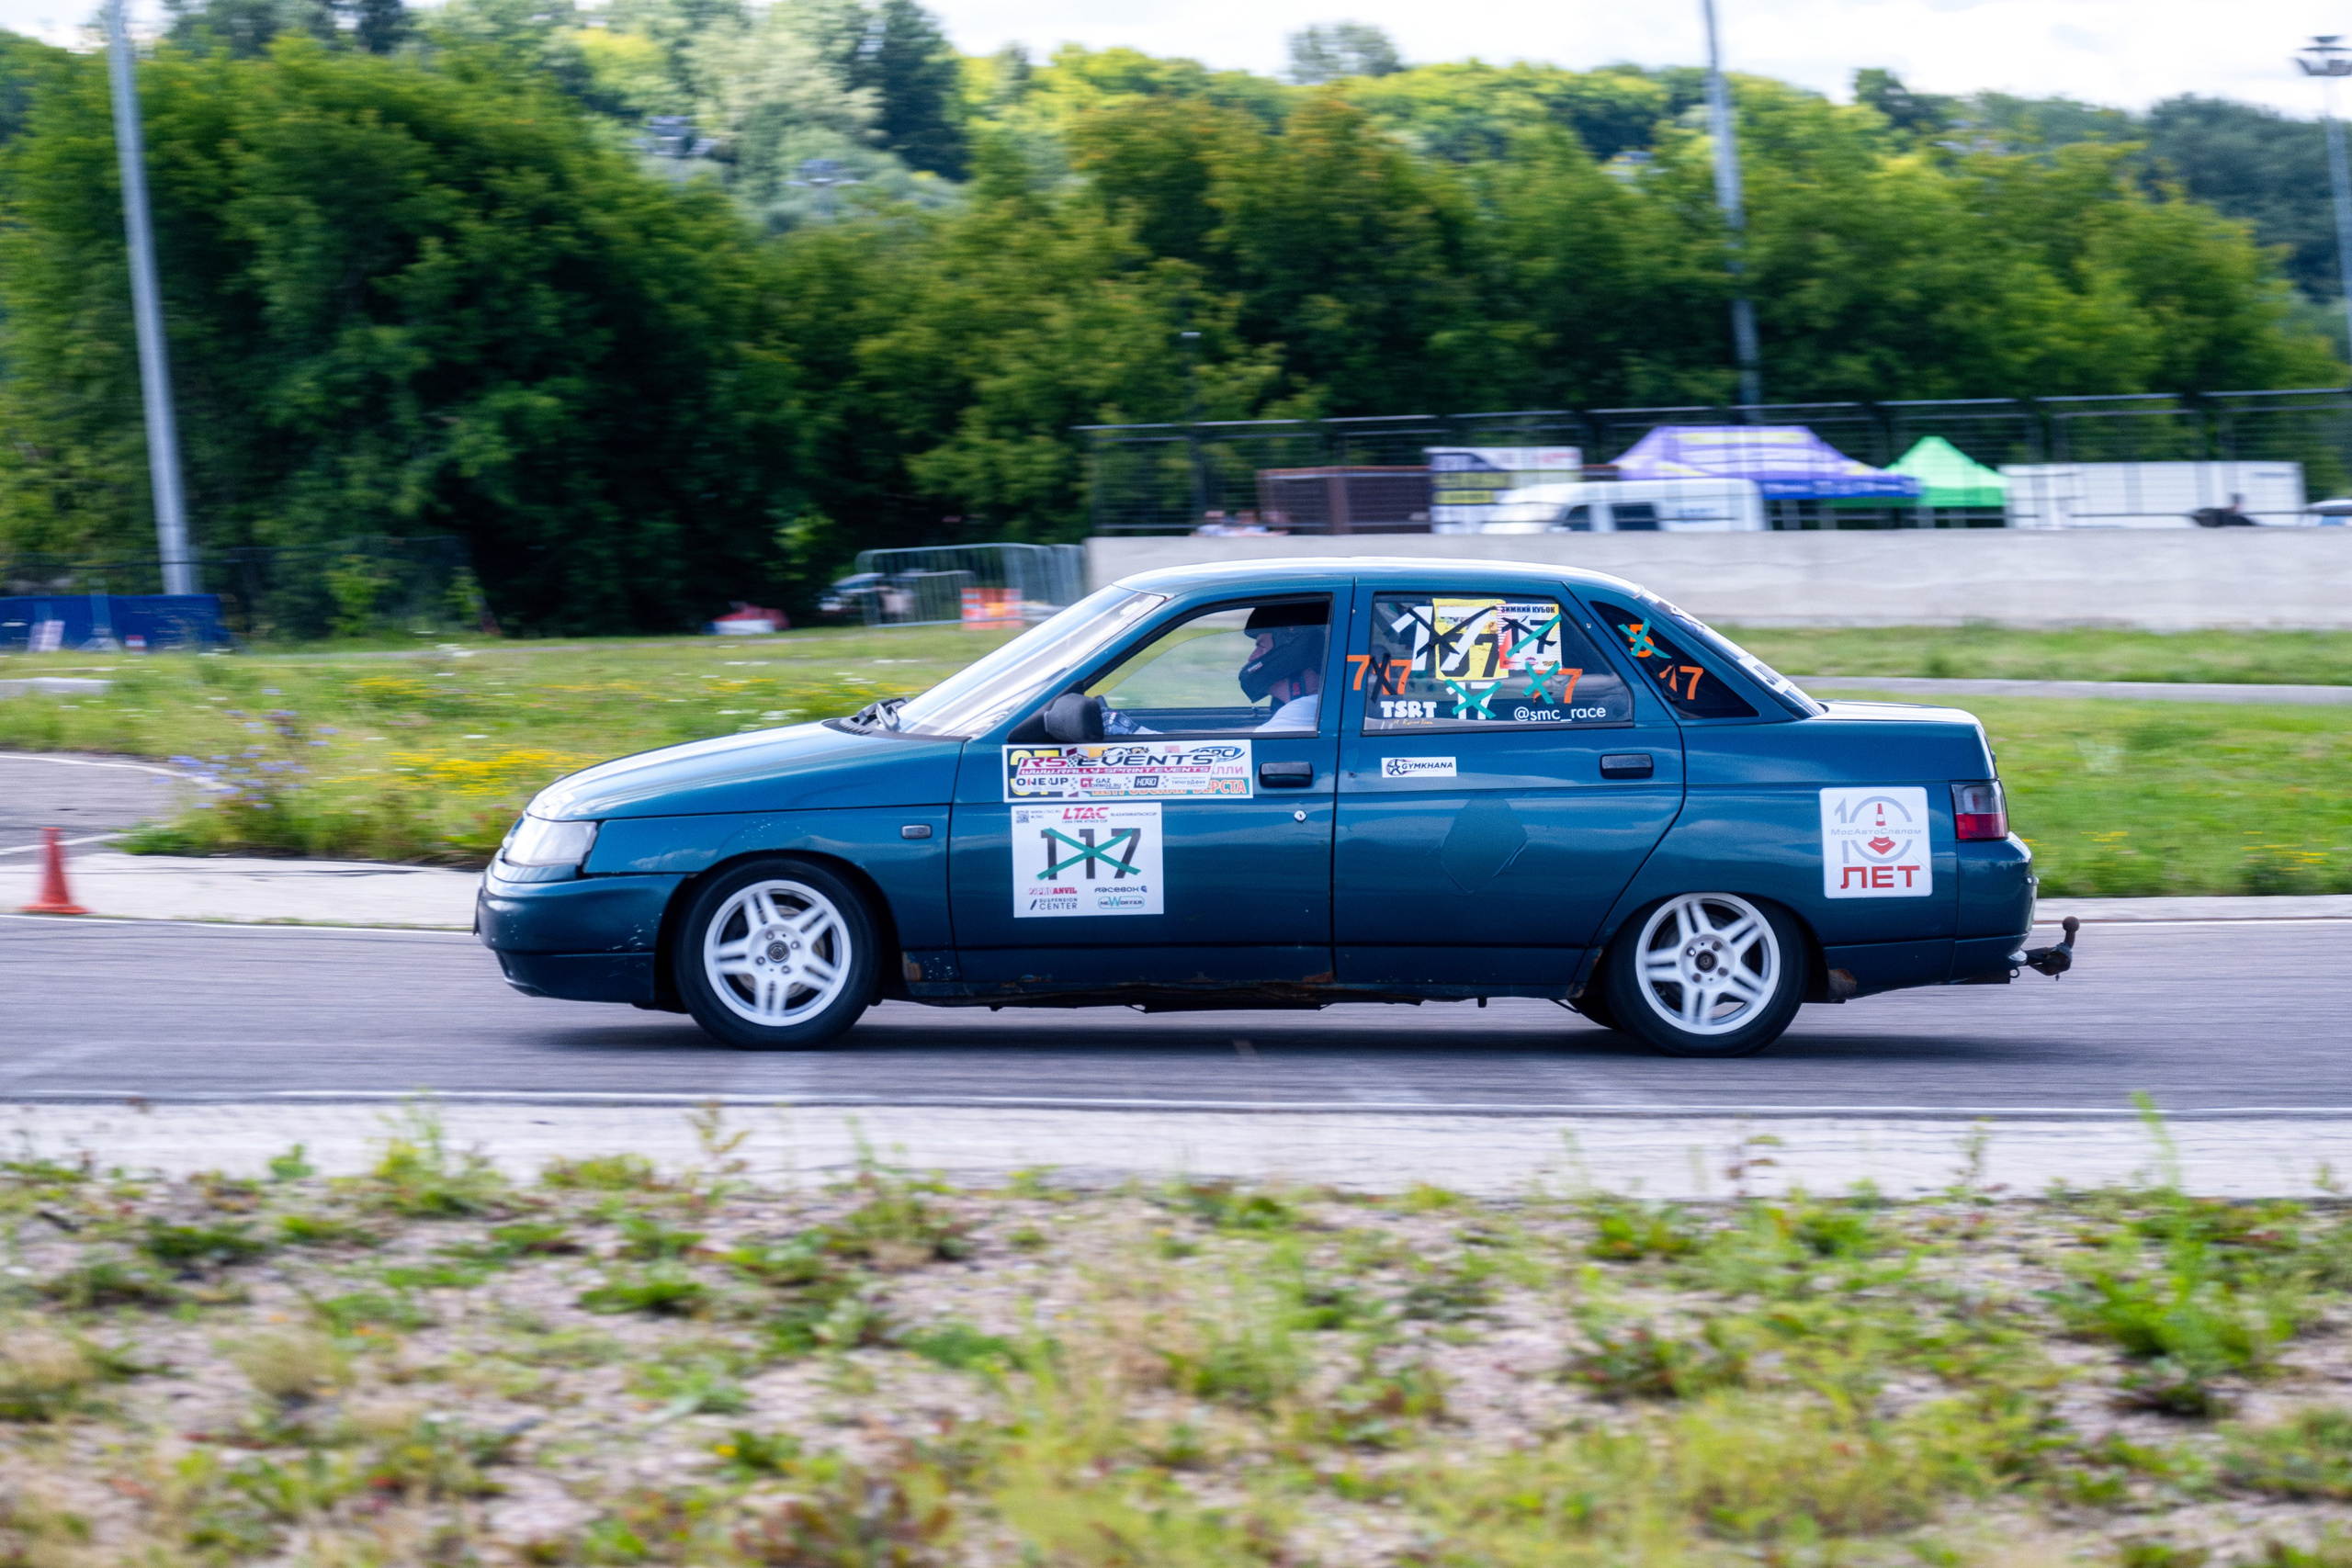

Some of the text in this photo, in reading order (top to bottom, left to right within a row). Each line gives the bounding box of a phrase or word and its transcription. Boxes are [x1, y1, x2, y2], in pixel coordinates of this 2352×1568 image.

[1380, 701, 1437, 718] TSRT
[1514, 706, 1607, 722] @smc_race
[1022, 757, 1067, 768] RS
[1076, 754, 1213, 766] EVENTS
[1401, 761, 1453, 770] GYMKHANA
[1062, 807, 1110, 820] LTAC
[1830, 828, 1922, 836] МосАвтоСлалом
[1040, 828, 1141, 880] 117
[1840, 865, 1921, 890] ЛЕТ
[1039, 902, 1078, 910] CENTER
